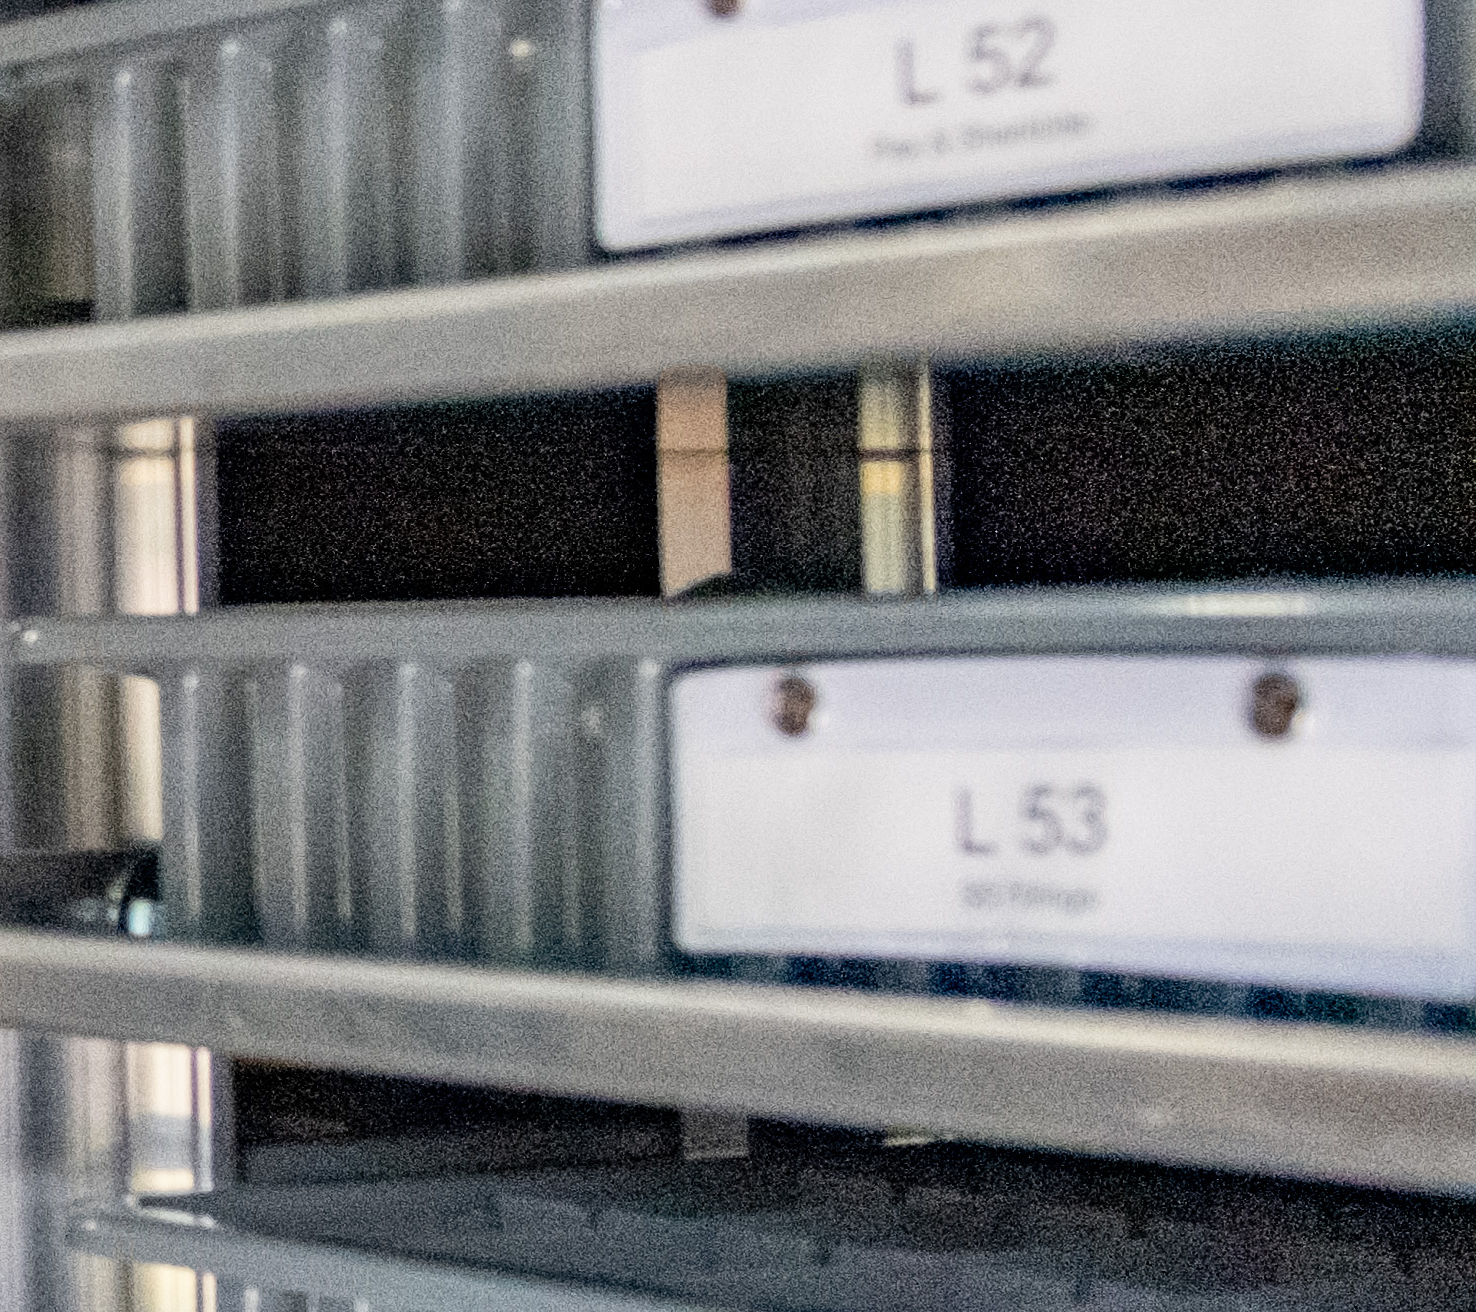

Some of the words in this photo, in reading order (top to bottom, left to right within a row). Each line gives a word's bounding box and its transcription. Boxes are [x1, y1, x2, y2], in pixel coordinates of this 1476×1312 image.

[895, 38, 940, 106] L
[967, 13, 1056, 94] 52
[954, 787, 997, 856] L
[1021, 782, 1108, 857] 53
